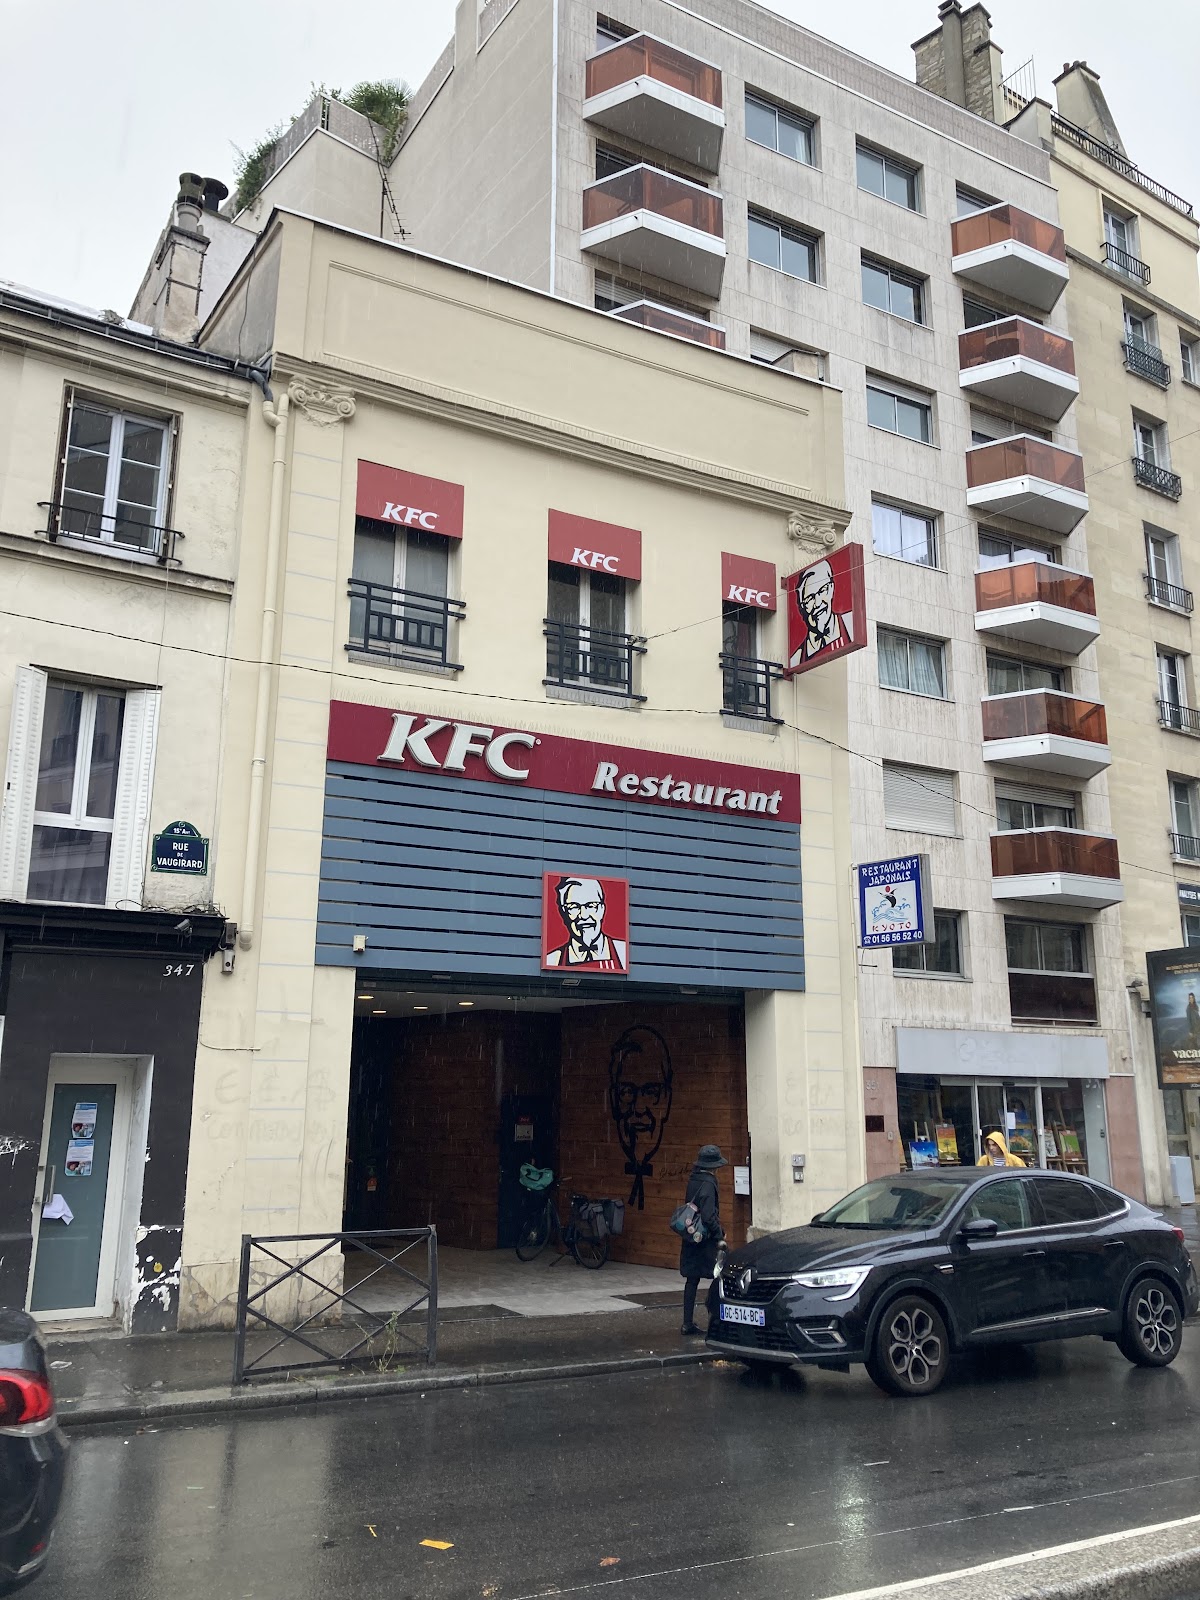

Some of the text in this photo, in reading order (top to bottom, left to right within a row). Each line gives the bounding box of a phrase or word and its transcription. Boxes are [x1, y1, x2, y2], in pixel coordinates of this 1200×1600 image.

[381, 502, 439, 530] KFC
[570, 547, 619, 573] KFC
[727, 584, 770, 607] KFC
[376, 712, 782, 816] KFC Restaurant
[172, 842, 189, 851] RUE
[157, 857, 203, 868] VAUGIRARD
[862, 859, 917, 876] RESTAURANT
[868, 871, 911, 886] JAPONAIS
[872, 930, 922, 943] 01 56 56 52 40
[163, 965, 195, 977] 347
[725, 1306, 758, 1322] GC-514-BC
